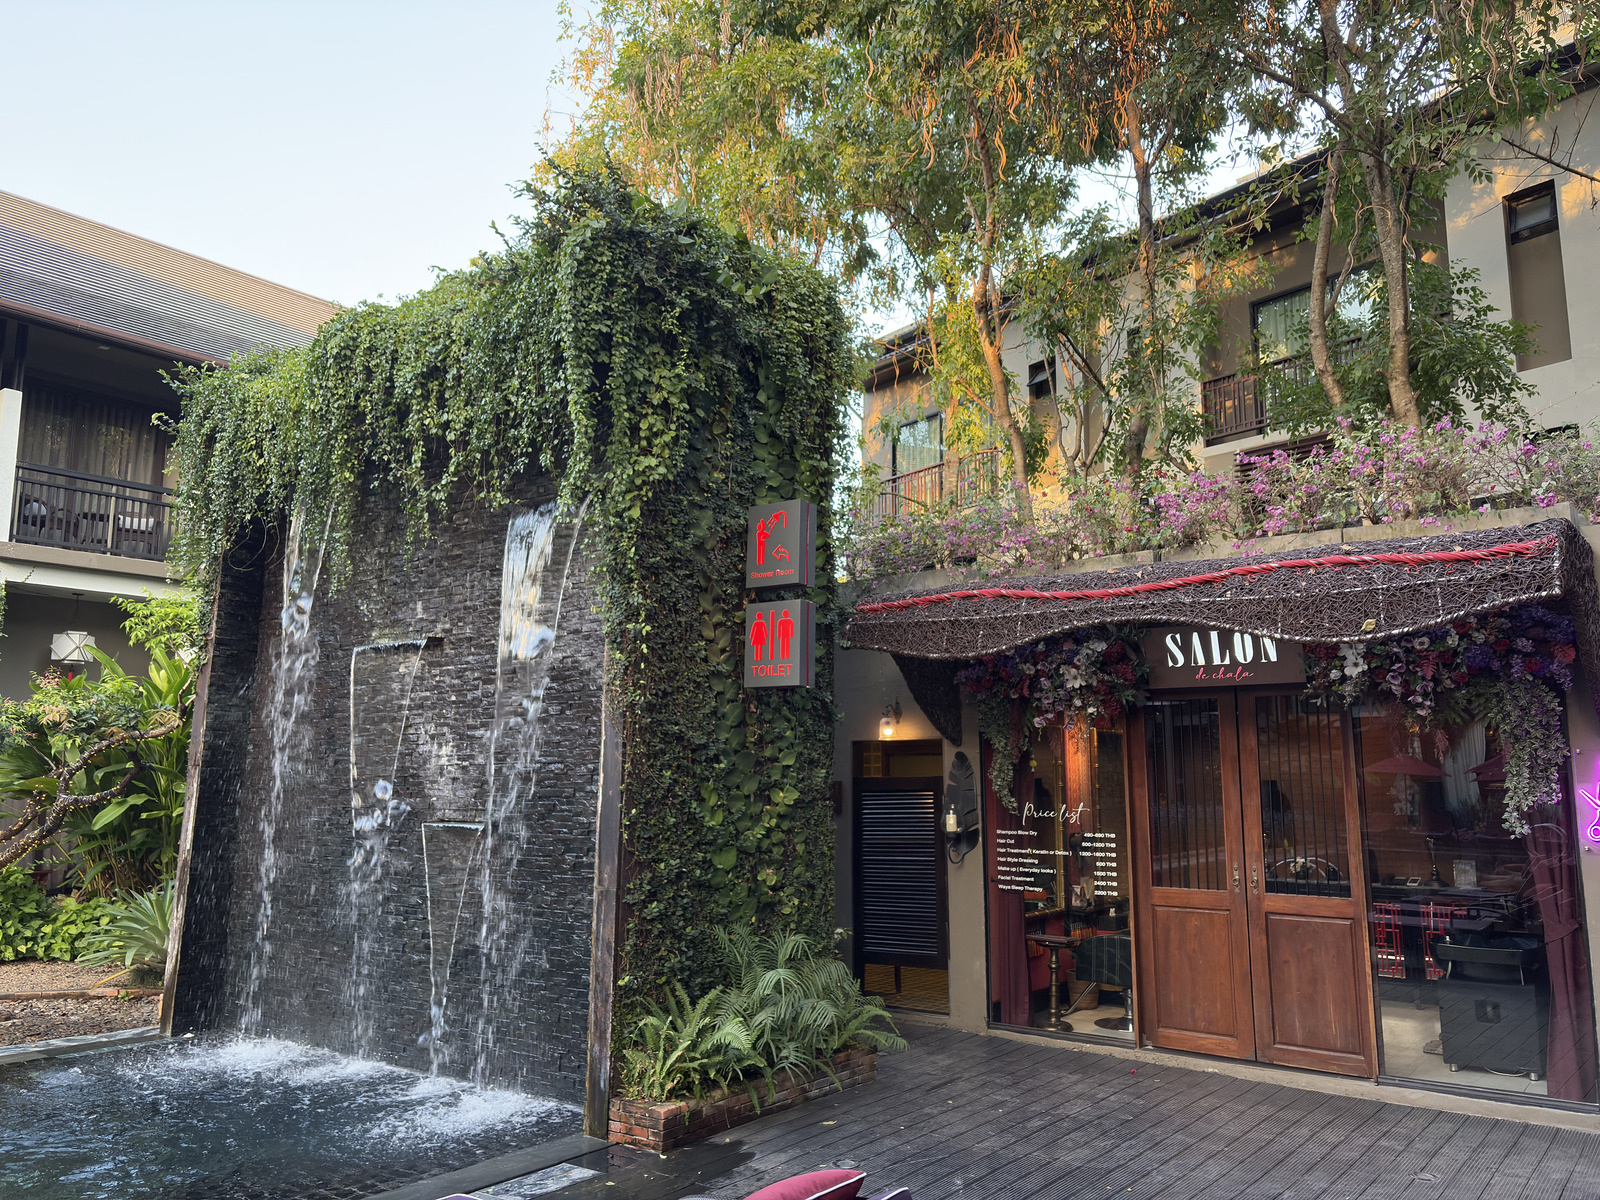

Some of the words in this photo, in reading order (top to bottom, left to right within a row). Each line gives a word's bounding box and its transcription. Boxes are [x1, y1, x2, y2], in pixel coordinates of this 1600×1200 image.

[775, 568, 794, 576] Room
[1165, 631, 1278, 668] SALON
[751, 664, 793, 677] TOILET
[1195, 667, 1209, 680] de
[1212, 666, 1254, 681] chala
[1022, 801, 1058, 826] Price
[1059, 802, 1091, 825] list
[1018, 857, 1039, 865] Dressing
[1024, 885, 1044, 893] Therapy
